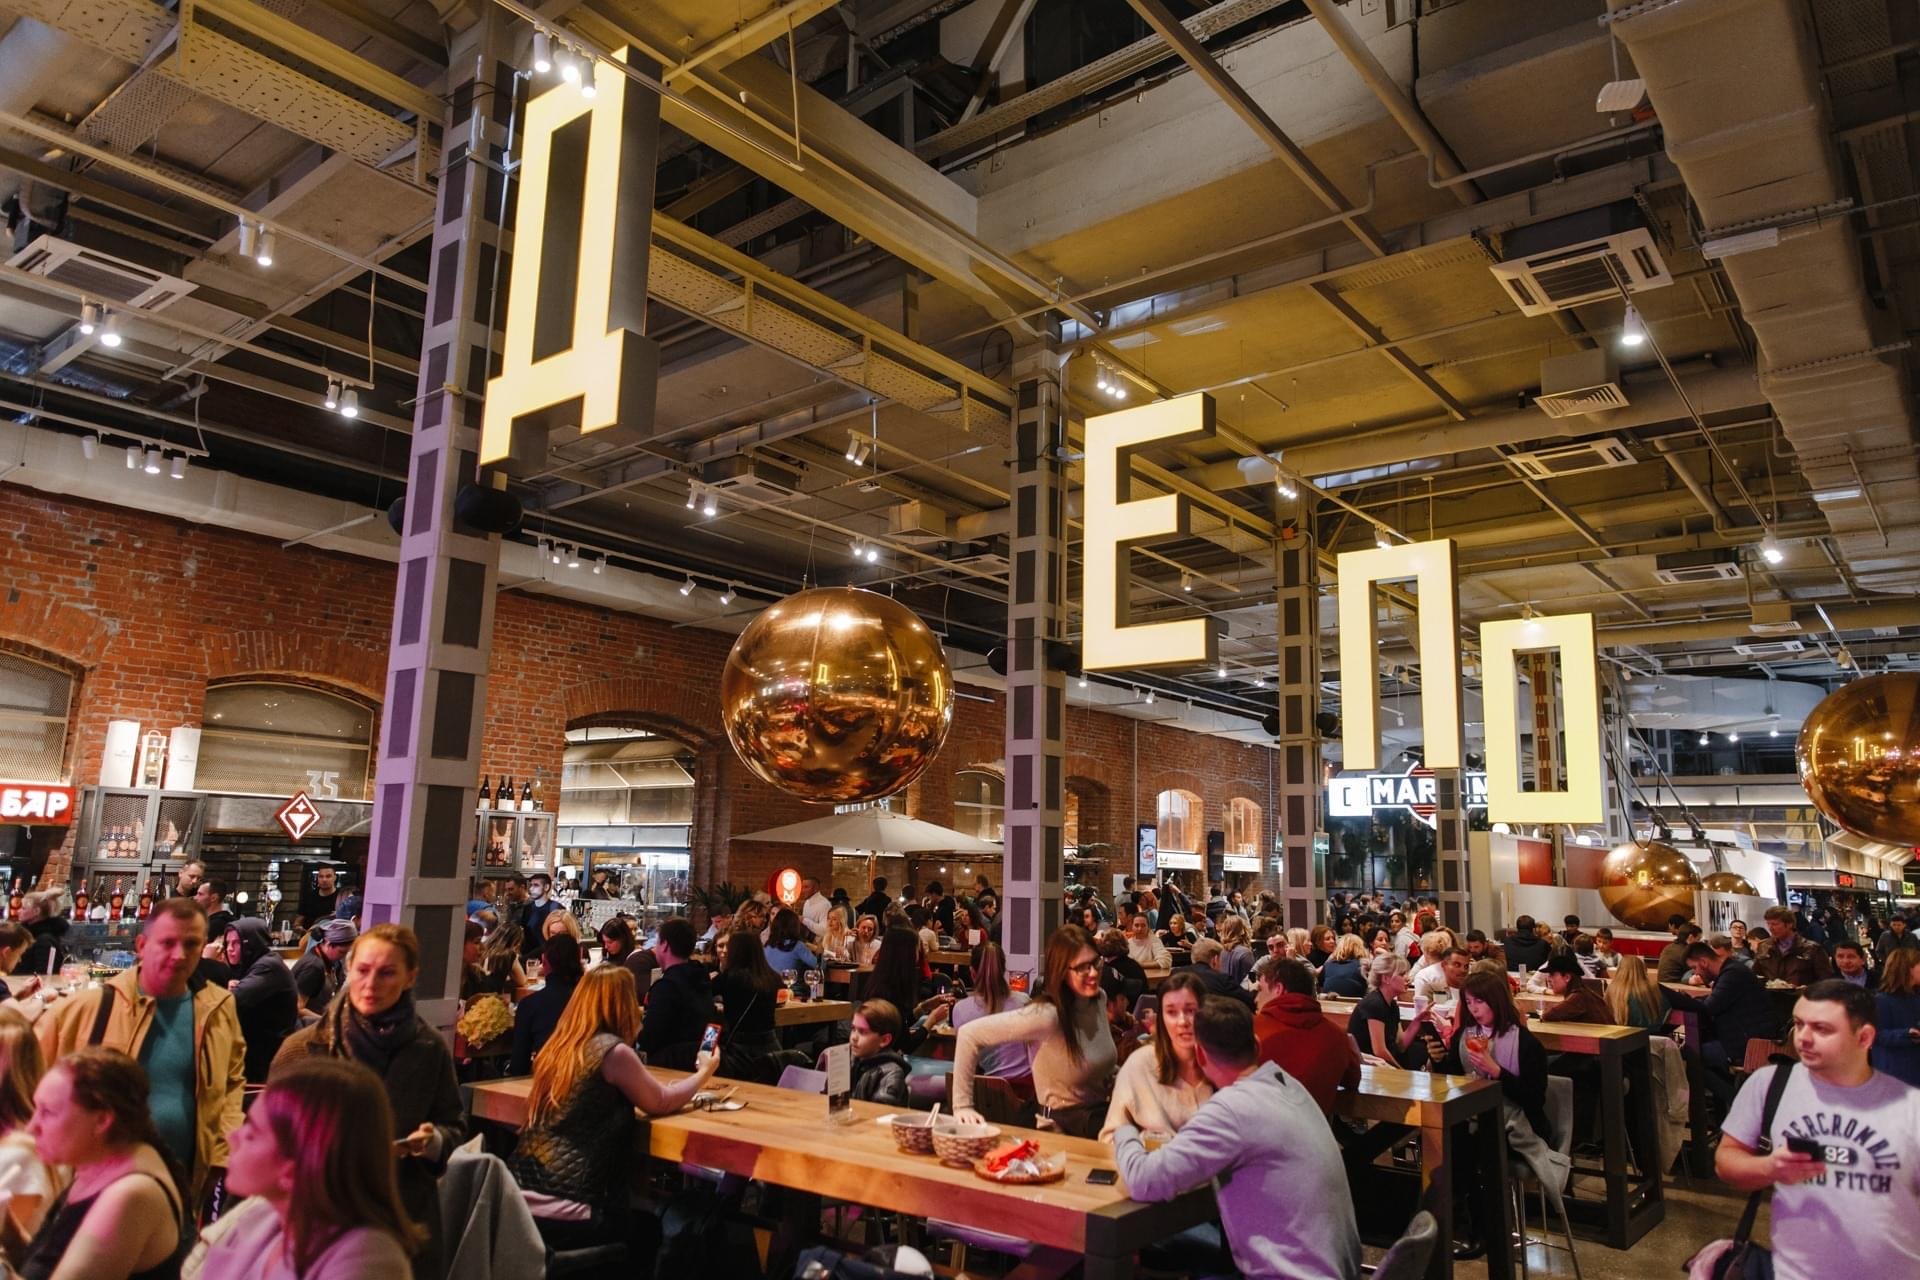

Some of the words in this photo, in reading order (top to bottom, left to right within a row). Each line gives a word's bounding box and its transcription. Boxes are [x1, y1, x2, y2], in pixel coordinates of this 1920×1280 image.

[306, 770, 340, 799] 35
[1825, 1146, 1849, 1163] 92
[1834, 1171, 1891, 1193] FITCH
